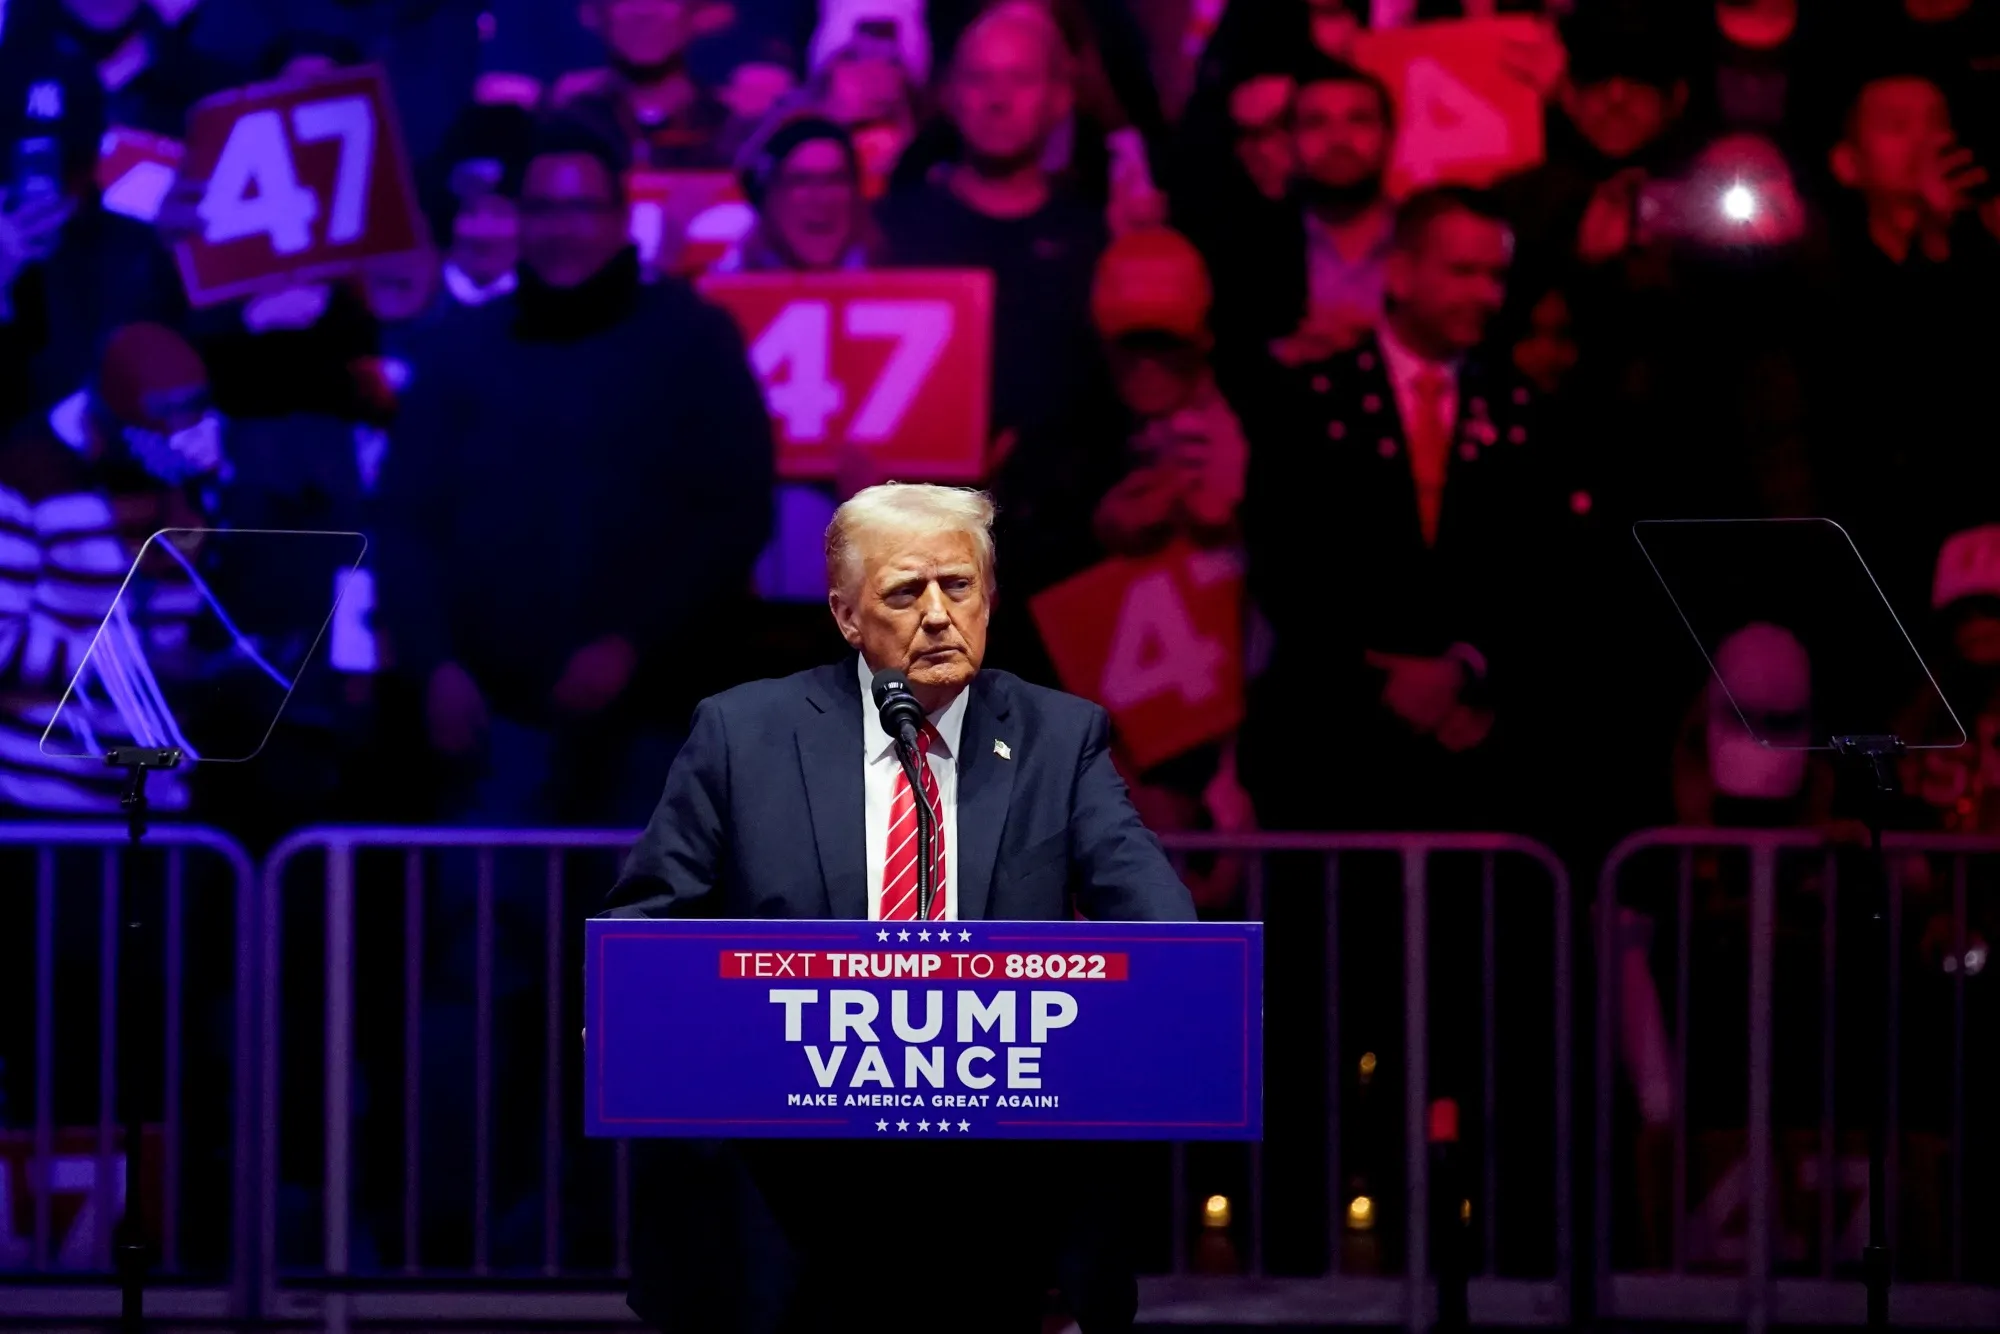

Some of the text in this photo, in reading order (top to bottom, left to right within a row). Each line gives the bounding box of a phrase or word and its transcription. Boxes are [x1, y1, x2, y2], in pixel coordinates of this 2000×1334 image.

[197, 98, 373, 254] 47
[750, 301, 953, 438] 47
[734, 952, 1106, 979] TEXT TRUMP TO 88022
[769, 988, 1079, 1044] TRUMP
[803, 1045, 1042, 1089] VANCE
[787, 1094, 1060, 1108] MAKE AMERICA GREAT AGAIN!
